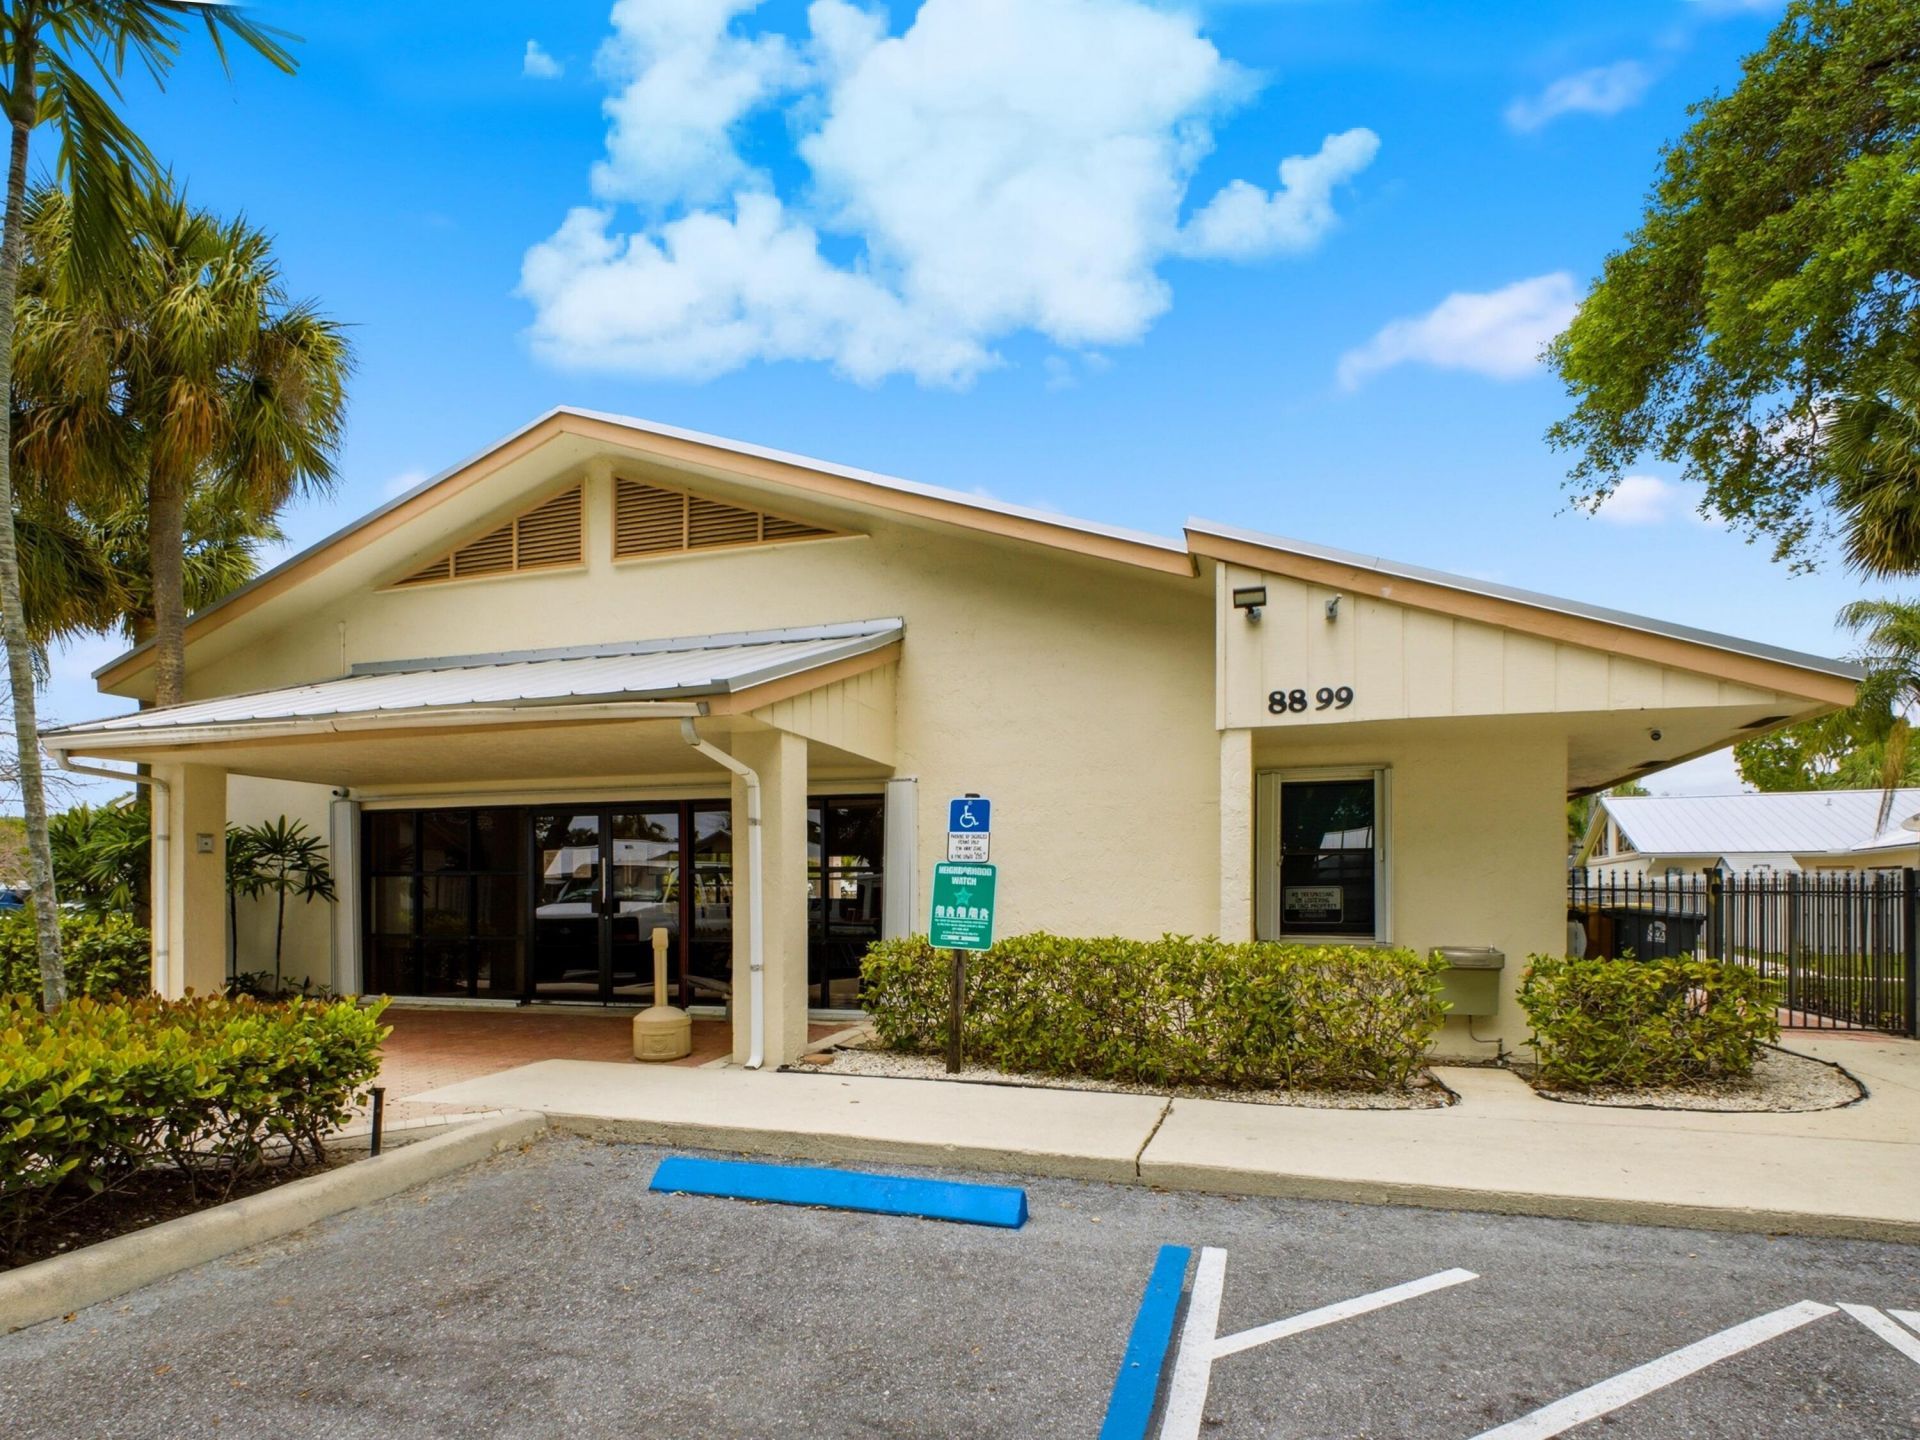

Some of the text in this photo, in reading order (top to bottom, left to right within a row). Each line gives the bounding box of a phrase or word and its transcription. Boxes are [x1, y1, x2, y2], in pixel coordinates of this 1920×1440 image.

[1268, 686, 1354, 715] 8899
[938, 866, 993, 876] NEIGHBORHOOD
[951, 876, 977, 886] WATCH
